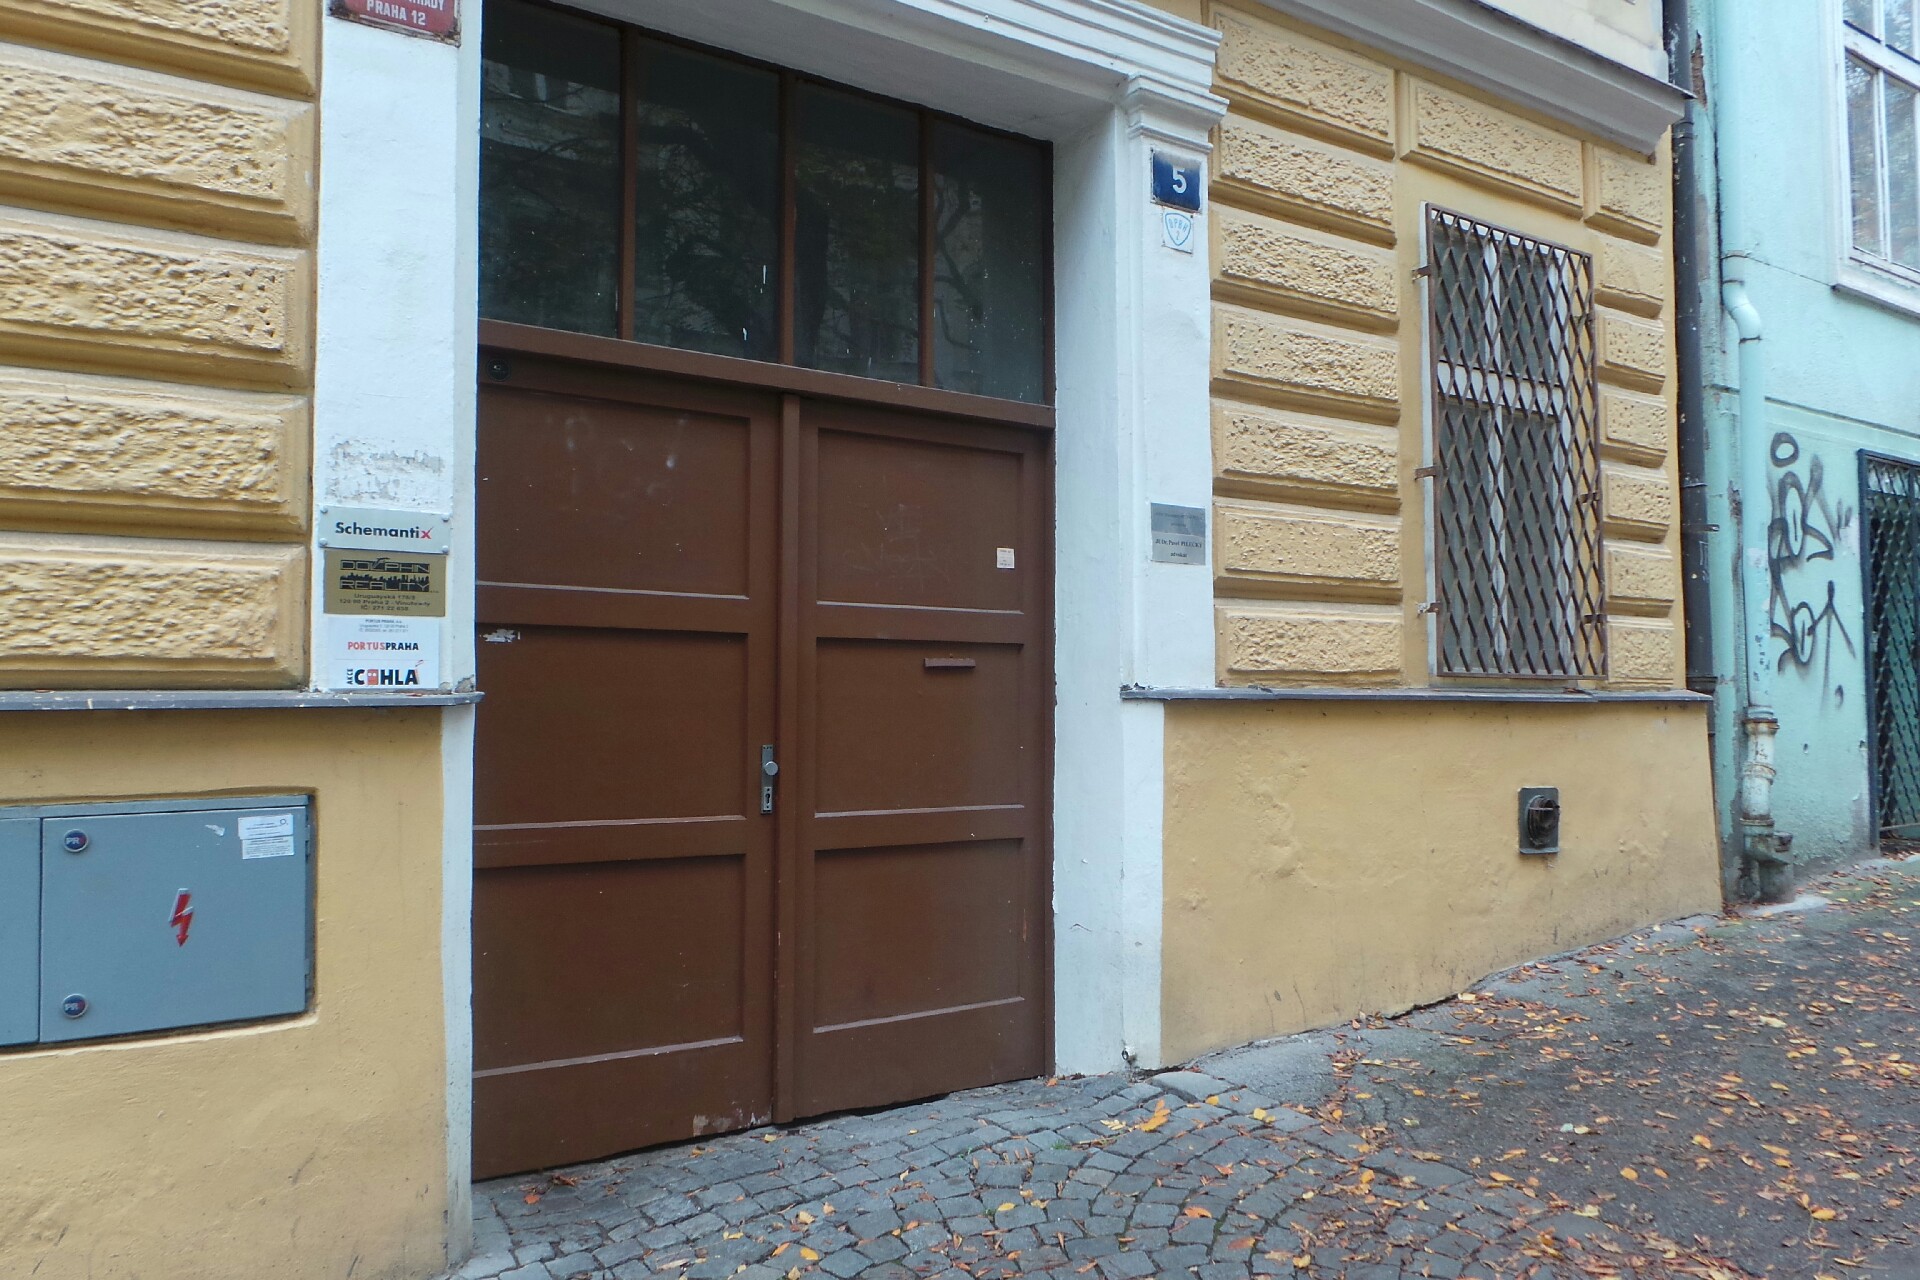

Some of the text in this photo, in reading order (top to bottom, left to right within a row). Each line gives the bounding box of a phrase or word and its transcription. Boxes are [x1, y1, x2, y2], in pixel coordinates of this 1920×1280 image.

[367, 0, 426, 25] PRAHA 12
[1172, 165, 1187, 194] 5
[335, 522, 434, 540] Schemantix
[340, 558, 430, 573] DOLPHIN
[340, 579, 430, 593] REALITY
[348, 641, 419, 651] PORTUSPRAHA
